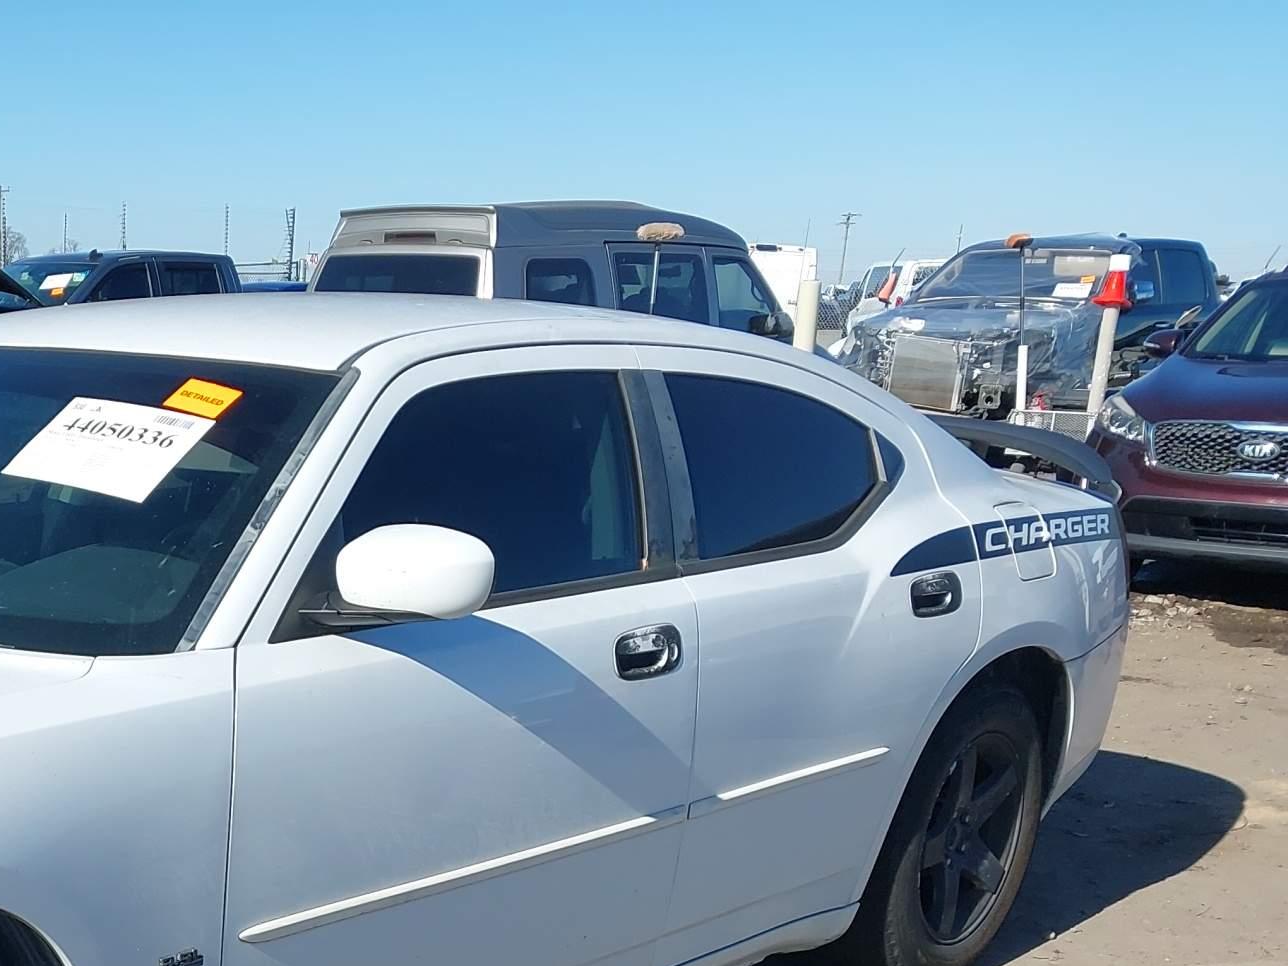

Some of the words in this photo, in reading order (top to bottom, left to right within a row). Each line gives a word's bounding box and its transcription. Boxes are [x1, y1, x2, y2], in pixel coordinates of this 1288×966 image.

[179, 388, 225, 407] DETAILED
[63, 417, 178, 450] 44050336
[1243, 444, 1272, 457] KIA
[985, 513, 1111, 552] CHARGER
